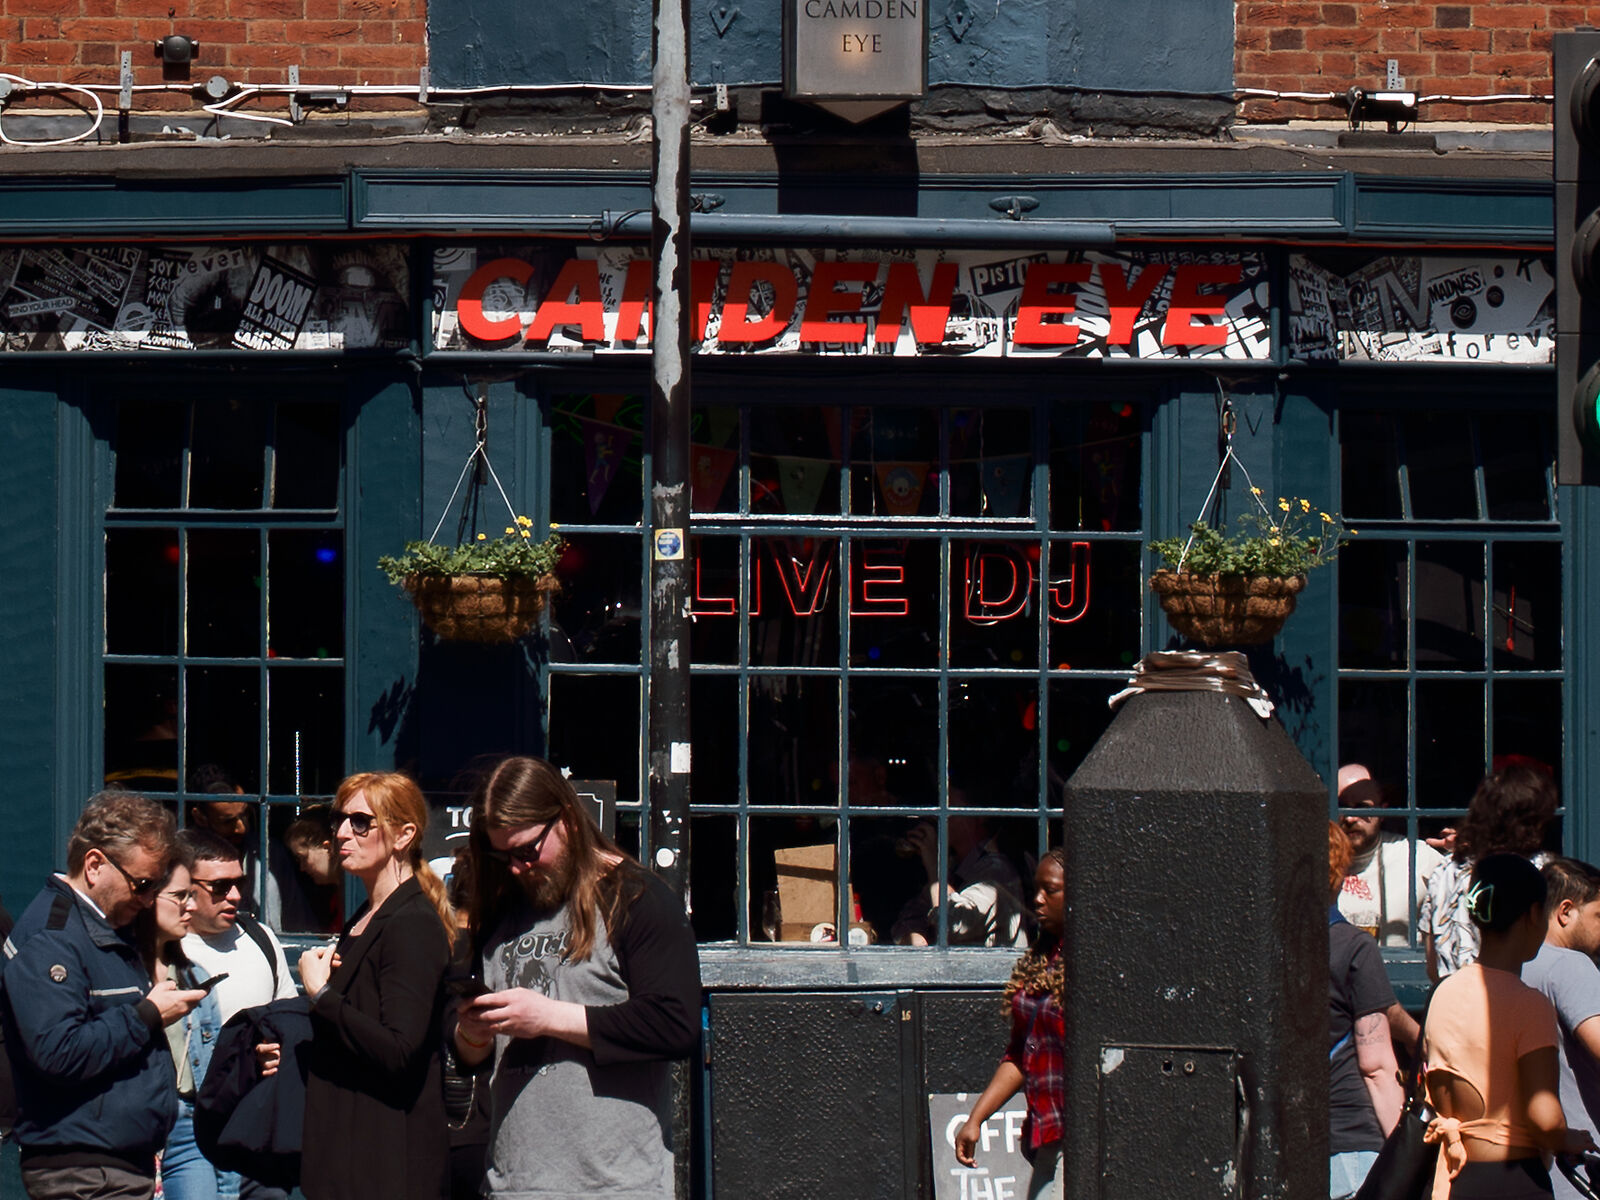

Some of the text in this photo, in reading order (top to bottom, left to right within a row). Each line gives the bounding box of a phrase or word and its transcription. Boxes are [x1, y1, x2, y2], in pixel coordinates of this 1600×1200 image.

[805, 0, 917, 19] CAMDEN
[842, 34, 882, 53] EYE
[972, 255, 1049, 296] PISTO
[1428, 271, 1481, 304] MADNESS
[29, 302, 50, 312] YOUR
[51, 298, 74, 308] HEAD
[249, 265, 313, 326] DOOM
[457, 257, 960, 344] CAMDEN
[1014, 262, 1243, 346] EYE
[243, 302, 263, 323] ALL
[234, 329, 280, 350] CAMD
[690, 537, 1091, 623] LIVE DJ
